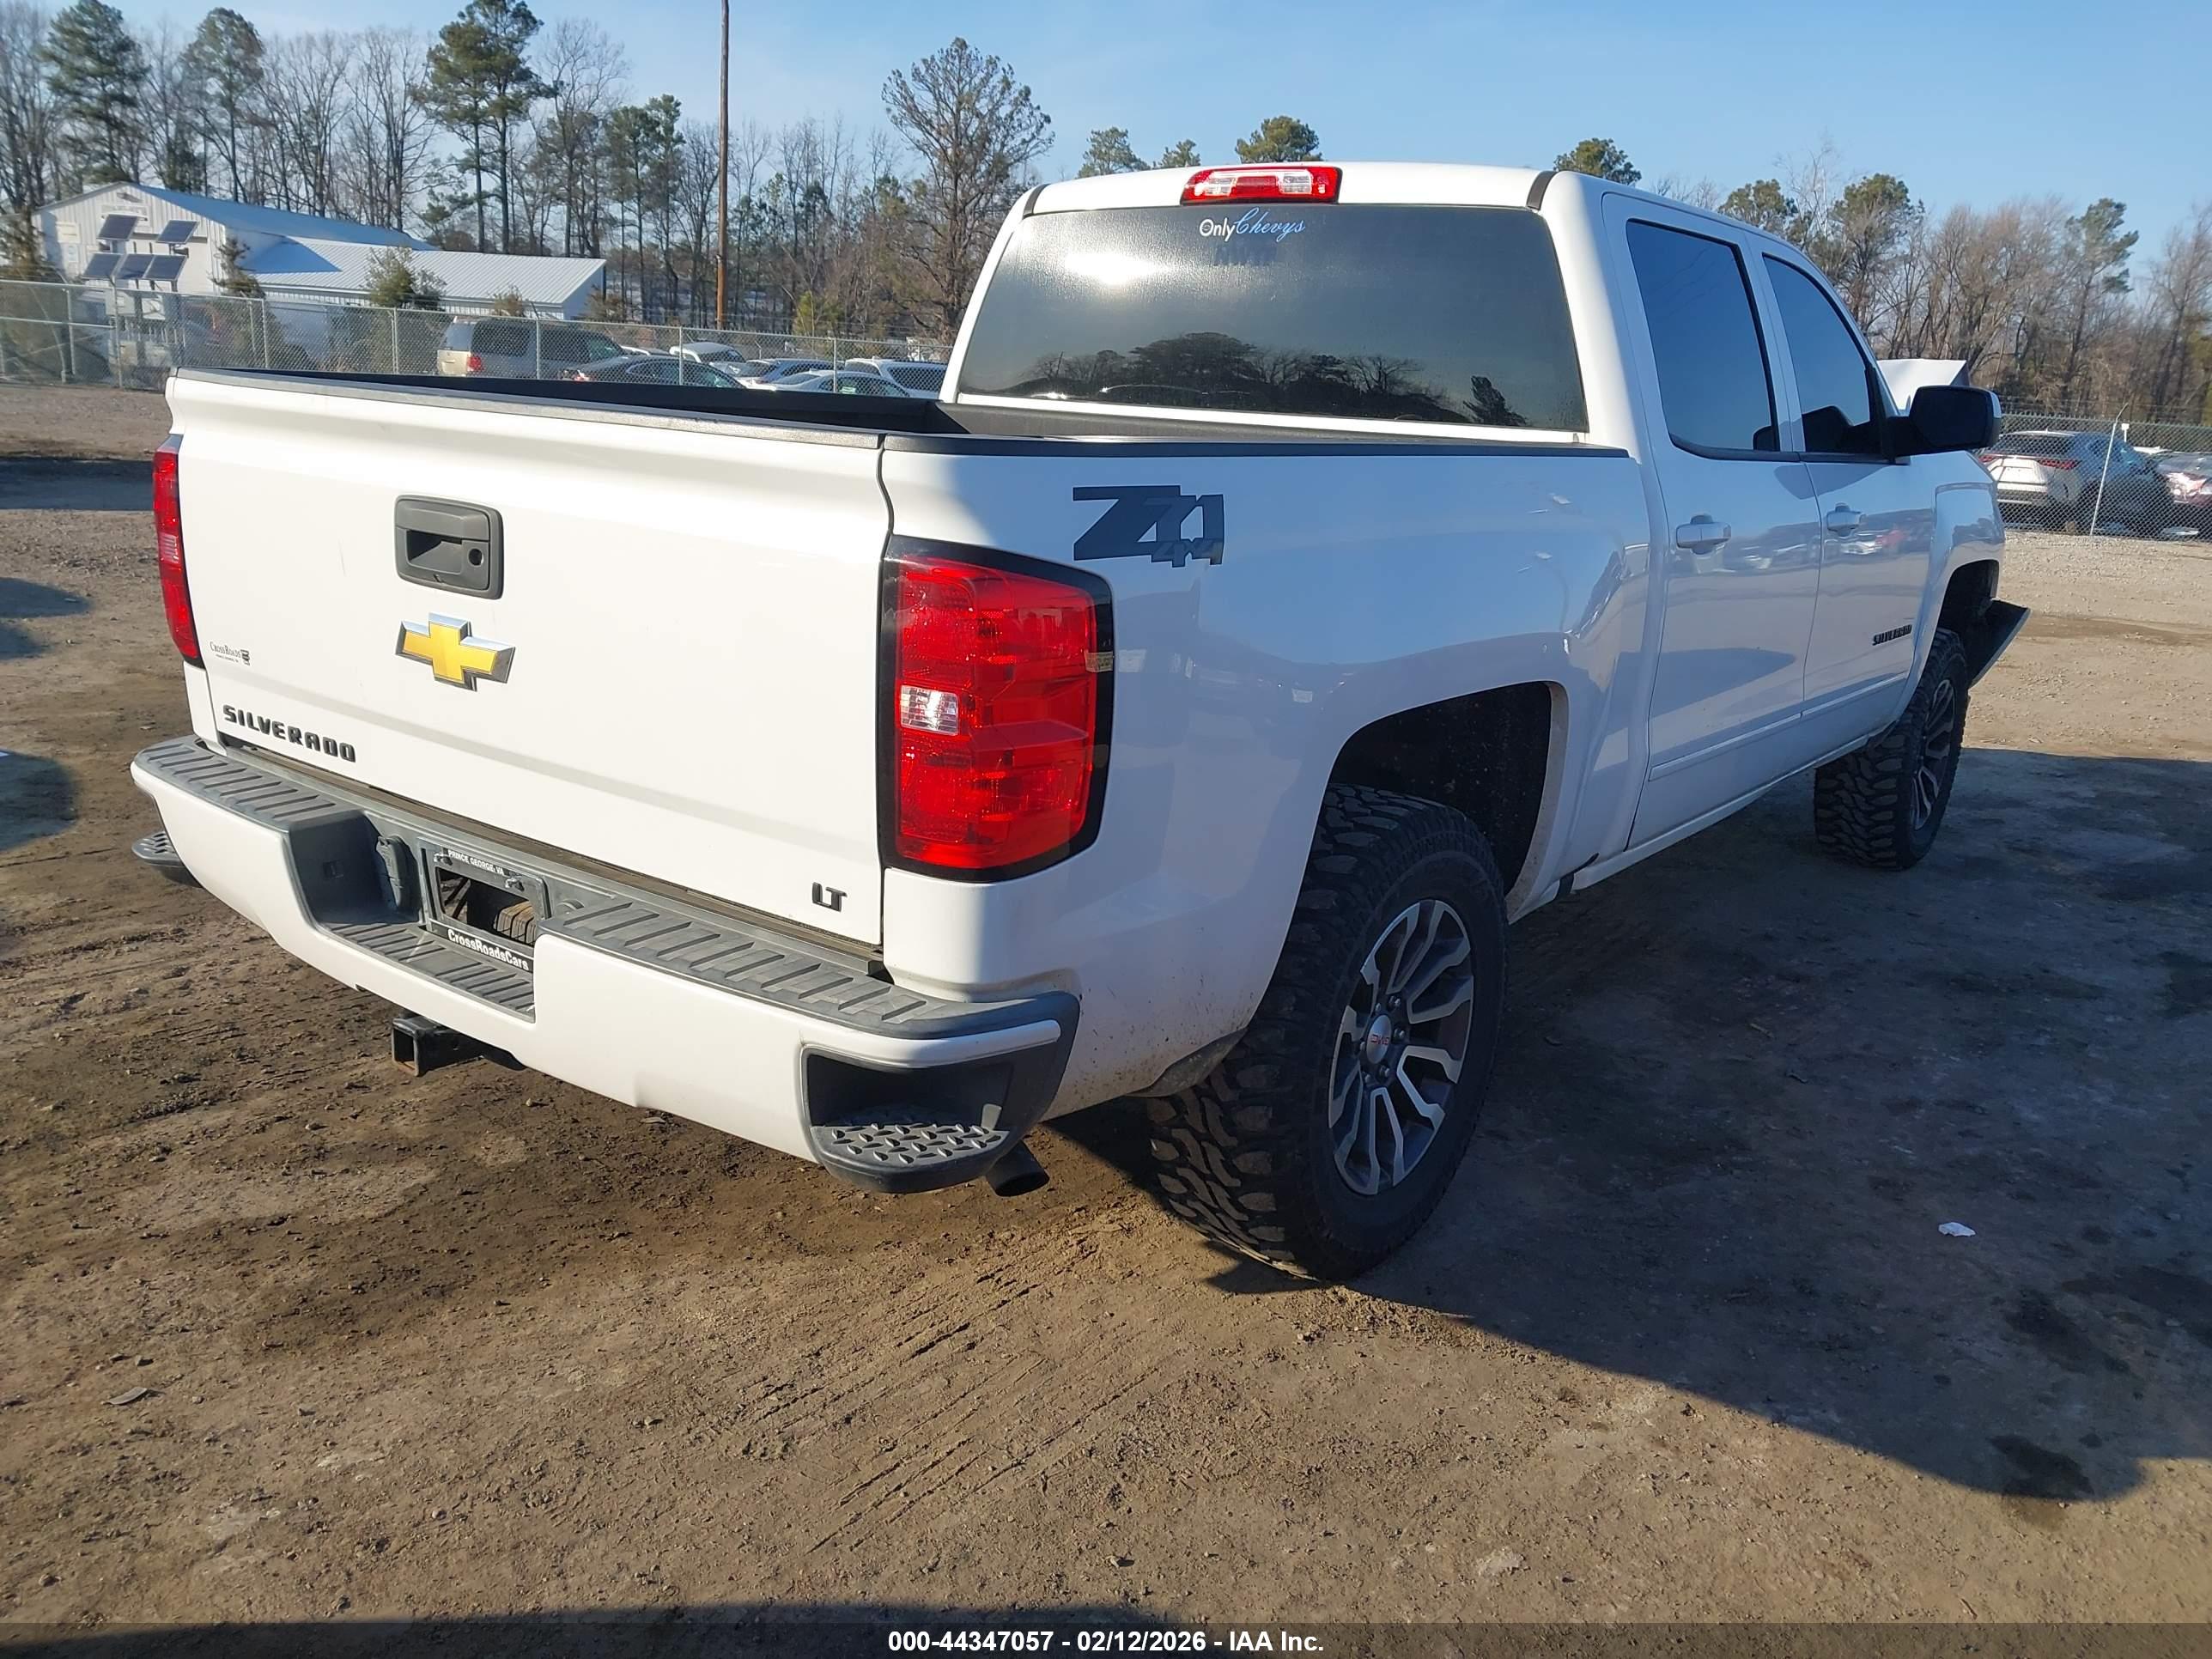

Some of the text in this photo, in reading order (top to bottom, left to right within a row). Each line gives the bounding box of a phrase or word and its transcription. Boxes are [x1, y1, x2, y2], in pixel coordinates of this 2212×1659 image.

[222, 704, 356, 763] SILVERADO
[447, 849, 470, 865] PRINCE
[495, 866, 506, 877] VA
[811, 881, 848, 912] LT
